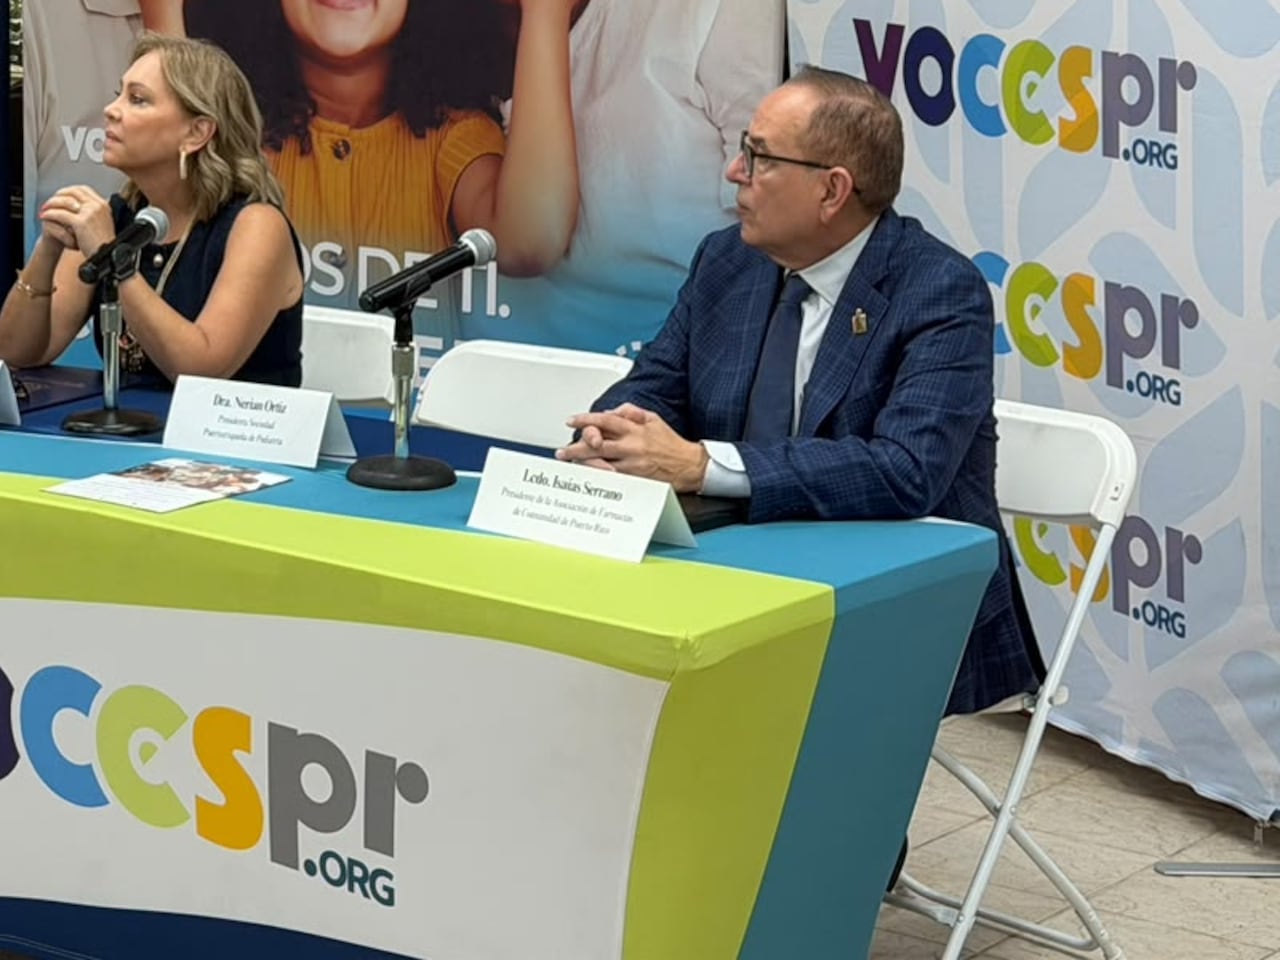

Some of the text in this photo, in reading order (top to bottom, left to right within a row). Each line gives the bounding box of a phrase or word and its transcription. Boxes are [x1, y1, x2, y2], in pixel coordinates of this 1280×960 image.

[1123, 138, 1179, 170] .ORG
[213, 394, 232, 407] Dra.
[1126, 370, 1182, 406] .ORG
[552, 475, 582, 494] Isaías
[583, 482, 623, 502] Serrano
[1132, 600, 1187, 638] .ORG
[303, 849, 396, 907] .ORG
